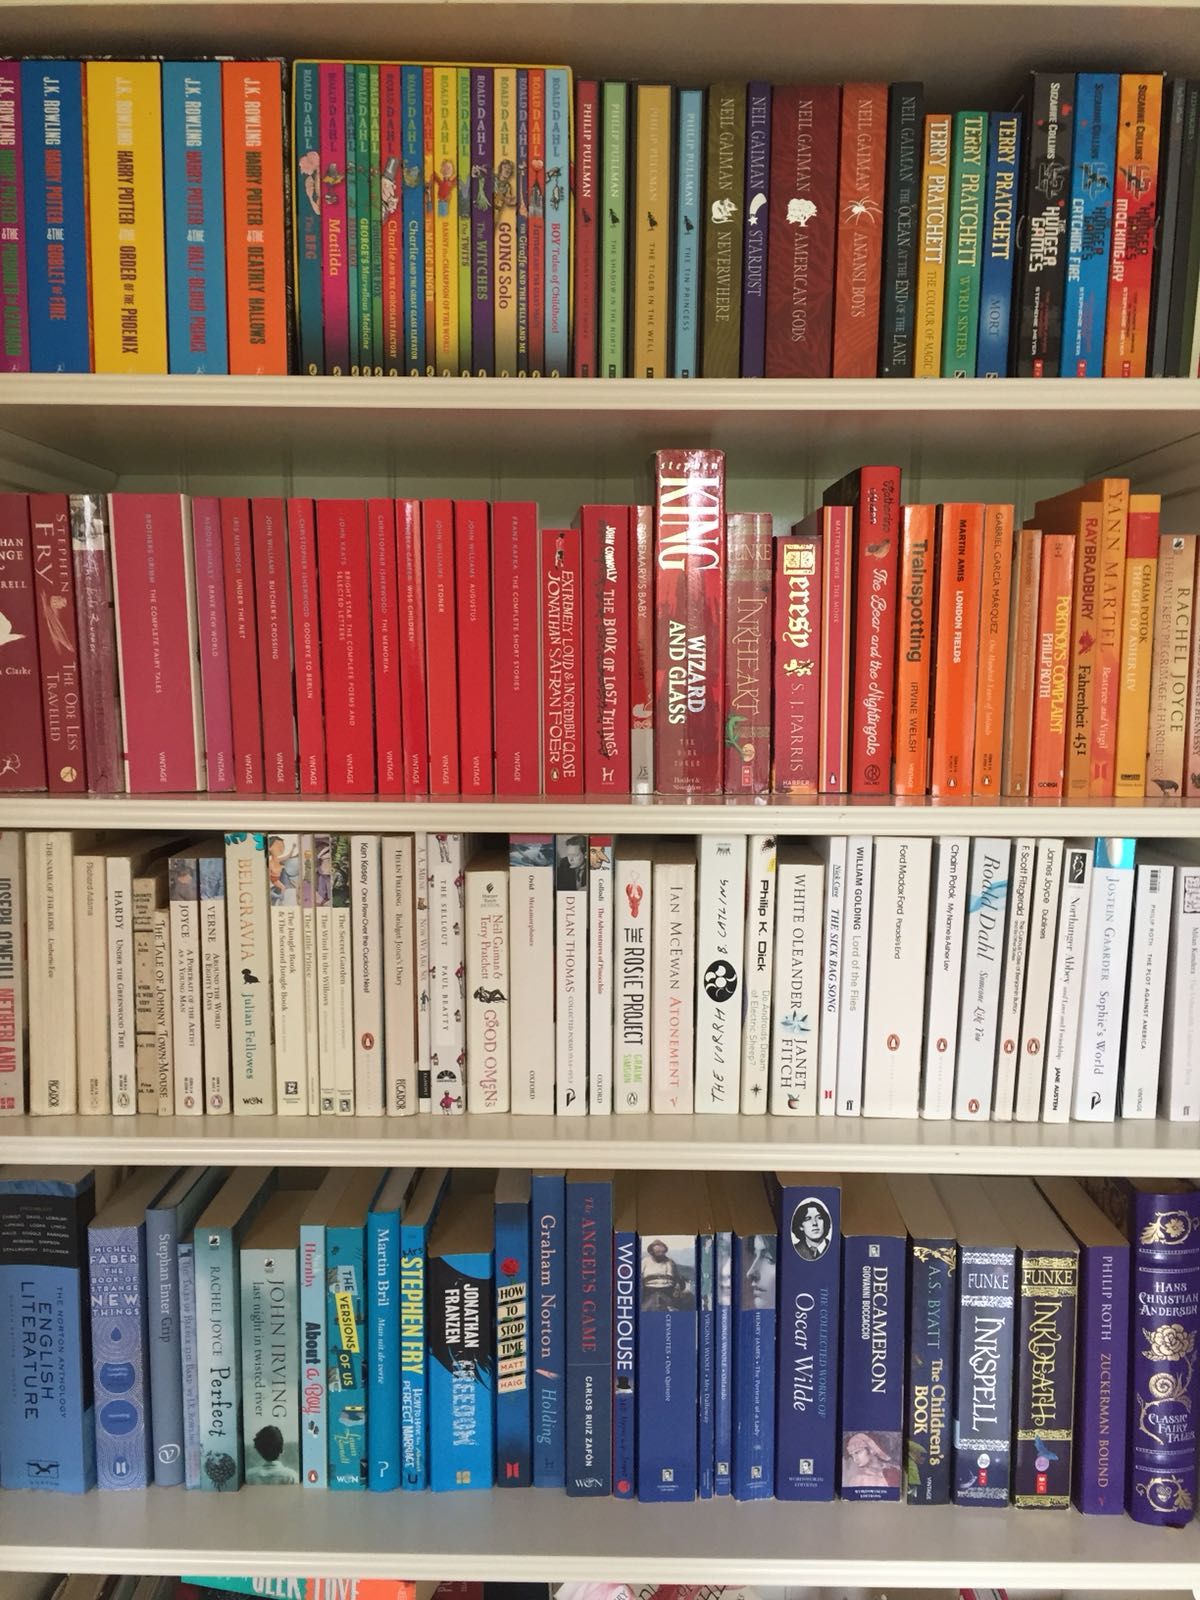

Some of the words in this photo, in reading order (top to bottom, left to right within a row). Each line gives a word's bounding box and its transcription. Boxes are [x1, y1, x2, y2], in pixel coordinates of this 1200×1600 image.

[43, 100, 61, 145] ROWLING
[245, 101, 261, 146] ROWLING
[583, 104, 591, 140] PHILIP
[798, 100, 812, 130] NEIL
[796, 134, 811, 191] GAIMAN
[928, 120, 948, 167] TERRY
[117, 151, 134, 182] HARRY
[583, 144, 592, 197] PULLMAN
[118, 187, 135, 224] POTTER
[924, 175, 946, 264] PRATCHETT
[1070, 199, 1084, 253] CATCHING
[329, 219, 341, 276] Matilda
[498, 223, 510, 271] GOING
[1029, 217, 1044, 272] GAMES
[1044, 206, 1059, 266] HUNGER
[120, 246, 136, 280] ORDER
[249, 246, 264, 293] DEATHLY
[477, 240, 487, 300] WITCHES
[716, 232, 731, 321] NEVERWHERE
[747, 230, 763, 296] STARDUST
[793, 233, 809, 305] AMERICAN
[1068, 257, 1080, 282] FIRE
[124, 294, 134, 305] THE
[125, 283, 133, 291] OF
[499, 276, 511, 309] Solo
[122, 308, 138, 354] PHOENIX
[250, 298, 265, 344] HALLOWS
[791, 310, 806, 342] GODS
[988, 299, 1000, 337] MORT
[657, 474, 720, 571] KING
[957, 520, 968, 555] MARTIN
[35, 522, 54, 584] FRY
[56, 513, 69, 593] STEPHEN
[957, 559, 966, 582] AMIS
[603, 589, 616, 613] THE
[782, 544, 815, 649] Heresy
[873, 569, 888, 590] The
[907, 539, 928, 663] Trainspotting
[548, 571, 562, 644] JONATHAN
[561, 571, 574, 635] EXTREMELY
[870, 595, 888, 633] Bear
[954, 590, 964, 628] LONDON
[1174, 587, 1191, 664] RACHEL
[270, 622, 279, 659] CROSSING
[562, 638, 575, 669] LOUD
[603, 618, 616, 653] BOOK
[668, 620, 684, 662] AND
[732, 596, 768, 715] INKHEART
[870, 636, 883, 657] and
[952, 632, 963, 663] FIELDS
[549, 649, 562, 705] SAFRAN
[563, 672, 574, 681] &
[603, 658, 615, 672] OF
[687, 635, 706, 713] WIZARD
[869, 661, 883, 678] the
[562, 682, 576, 740] INCREDIBLY
[603, 676, 616, 705] LOST
[668, 666, 685, 724] GLASS
[790, 683, 804, 695] S.
[790, 701, 804, 709] J.
[909, 682, 919, 714] IRVINE
[1076, 665, 1091, 728] Fahrenheit
[1170, 673, 1187, 733] JOYCE
[549, 710, 562, 763] FOER
[602, 709, 618, 757] THINGS
[862, 682, 886, 756] Nightingale
[908, 719, 918, 753] WELSH
[562, 741, 576, 778] CLOSE
[789, 715, 804, 771] PARRIS
[1074, 733, 1087, 756] 451
[855, 846, 864, 886] WILLIAM
[981, 855, 1000, 911] Roald
[114, 890, 124, 930] HARDY
[237, 859, 254, 961] BELGRAVIA
[565, 896, 575, 937] DYLAN
[758, 880, 768, 916] Philip
[793, 874, 806, 923] WHITE
[830, 909, 839, 931] THE
[853, 889, 862, 930] GOLDING
[179, 904, 190, 938] JOYCE
[207, 906, 216, 942] VERNE
[339, 930, 347, 953] Secret
[479, 914, 491, 938] Terry
[758, 922, 767, 936] K.
[976, 914, 996, 961] Dahl
[481, 941, 491, 979] Pratchett
[565, 940, 576, 993] THOMAS
[757, 941, 767, 971] Dick
[829, 934, 838, 957] SICK
[791, 928, 804, 1009] OLEANDER
[828, 959, 837, 980] BAG
[242, 993, 255, 1027] Julian
[623, 994, 643, 1045] PROJECT
[827, 983, 836, 1013] SONG
[1096, 991, 1110, 1036] Sophie's
[244, 1030, 257, 1079] Fellowes
[713, 1008, 725, 1063] VORRH
[1093, 1040, 1106, 1075] World
[711, 1070, 724, 1102] THE
[780, 1039, 792, 1088] FITCH
[794, 1039, 807, 1089] JANET
[48, 1080, 58, 1107] PICADOR
[158, 1233, 170, 1281] Stephan
[376, 1229, 390, 1278] Martin
[540, 1215, 555, 1286] Graham
[581, 1218, 595, 1293] ANGEL'S
[160, 1284, 171, 1315] Enter
[252, 1282, 265, 1300] last
[377, 1281, 390, 1306] Bril
[401, 1257, 423, 1336] STEPHEN
[1023, 1270, 1074, 1286] FUNKE
[1102, 1256, 1113, 1299] PHILIP
[250, 1303, 264, 1333] night
[266, 1279, 285, 1336] JOHN
[339, 1296, 356, 1349] VERSIONS
[444, 1289, 461, 1344] FRANZEN
[463, 1284, 479, 1348] JONATHAN
[541, 1295, 555, 1358] Norton
[582, 1300, 596, 1352] GAME
[616, 1243, 633, 1370] WODEHOUSE
[794, 1292, 815, 1349] Oscar
[1101, 1304, 1113, 1341] ROTH
[20, 1281, 39, 1419] LITERATURE
[38, 1302, 54, 1400] ENGLISH
[158, 1317, 172, 1343] Grip
[253, 1335, 265, 1346] in
[306, 1322, 321, 1364] About
[664, 1314, 672, 1354] CERVANTES
[871, 1266, 888, 1393] DECAMERON
[253, 1349, 265, 1389] twisted
[272, 1344, 287, 1418] IRVING
[402, 1342, 424, 1375] FRY
[931, 1358, 943, 1381] The
[969, 1316, 1005, 1432] INKSPELL
[1028, 1300, 1063, 1427] INKDEATH
[208, 1367, 230, 1438] Perfect
[254, 1392, 266, 1416] river
[585, 1376, 593, 1411] CARLOS
[792, 1355, 813, 1412] Wilde
[1099, 1354, 1111, 1434] ZUCKERMAN
[537, 1389, 556, 1445] Holding
[585, 1414, 593, 1436] RUIZ
[913, 1386, 928, 1434] BOOK
[929, 1385, 946, 1465] Children's
[585, 1438, 594, 1466] ZAFÓN
[1097, 1440, 1108, 1487] BOUND
